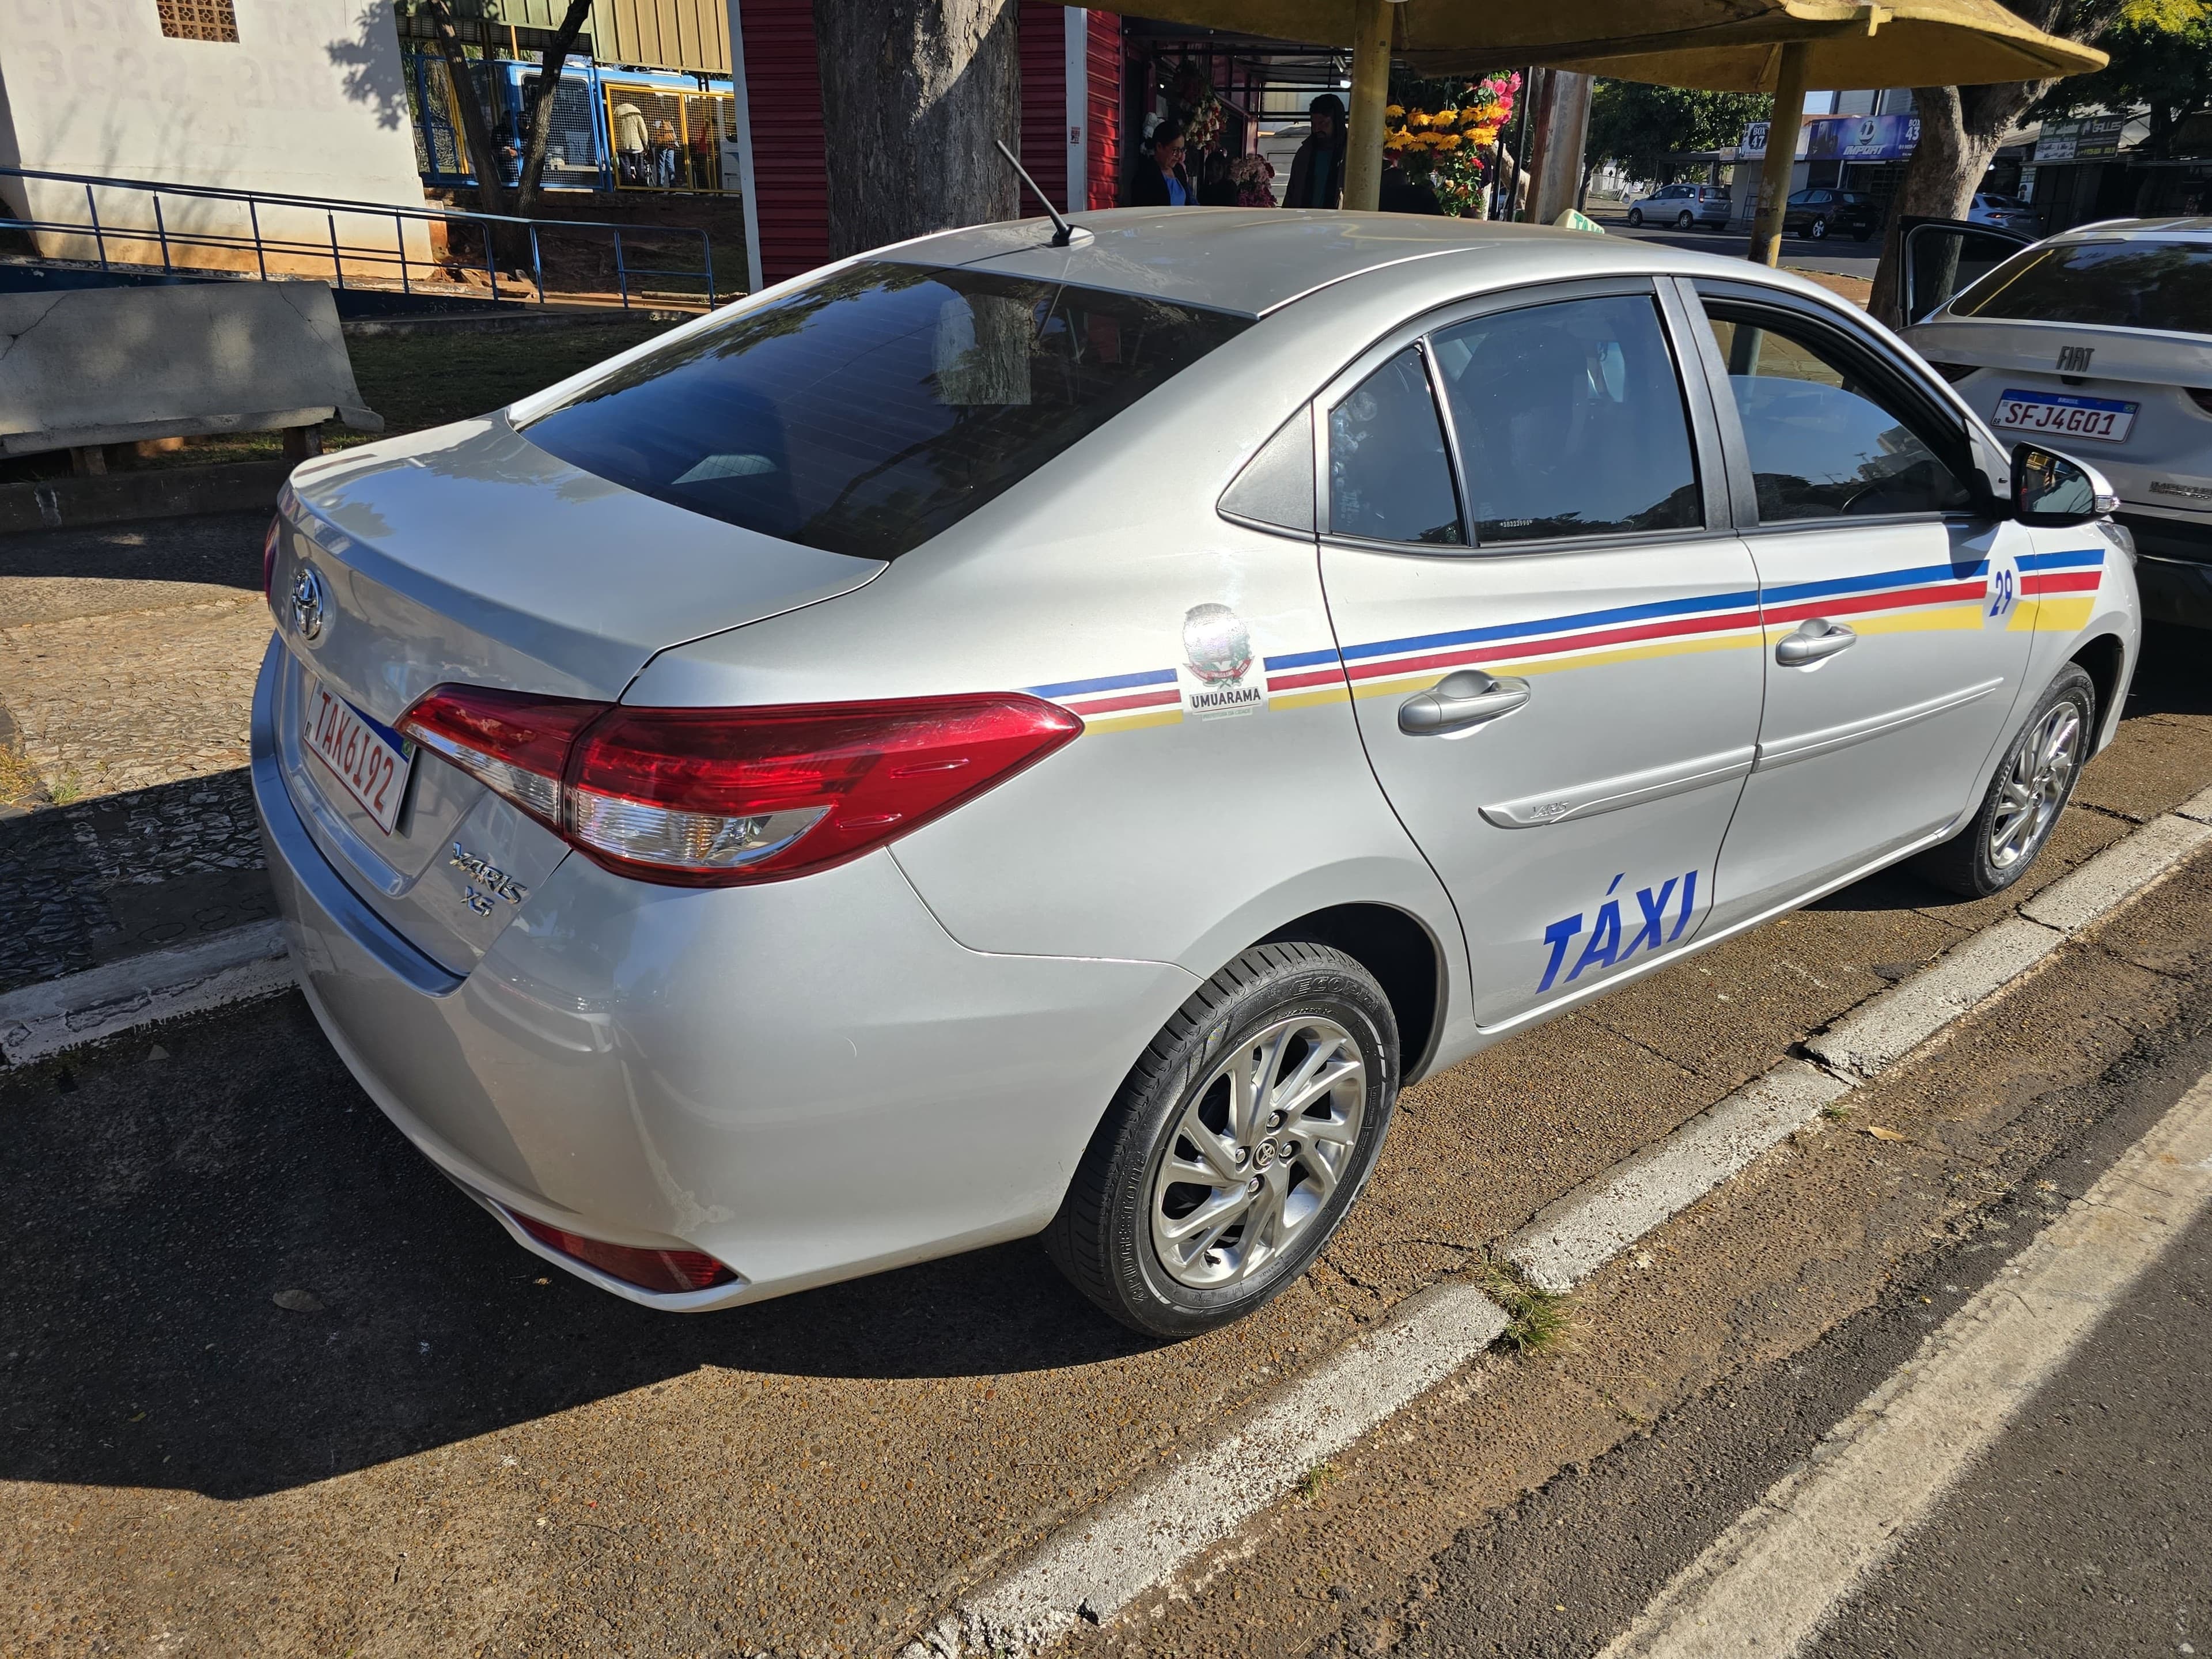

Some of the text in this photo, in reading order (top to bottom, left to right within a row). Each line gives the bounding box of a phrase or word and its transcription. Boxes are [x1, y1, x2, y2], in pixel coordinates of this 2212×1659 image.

[1753, 126, 1766, 135] BOX
[1908, 119, 1921, 127] BOX
[1751, 135, 1765, 148] 47
[1906, 126, 1920, 141] 43
[1843, 145, 1887, 155] IMPORT
[2056, 346, 2095, 372] FIAT
[2005, 403, 2116, 435] SFJ4G01
[1989, 569, 2013, 617] 29
[1192, 688, 1261, 709] UMUARAMA
[1535, 869, 1698, 994] TÁXI
